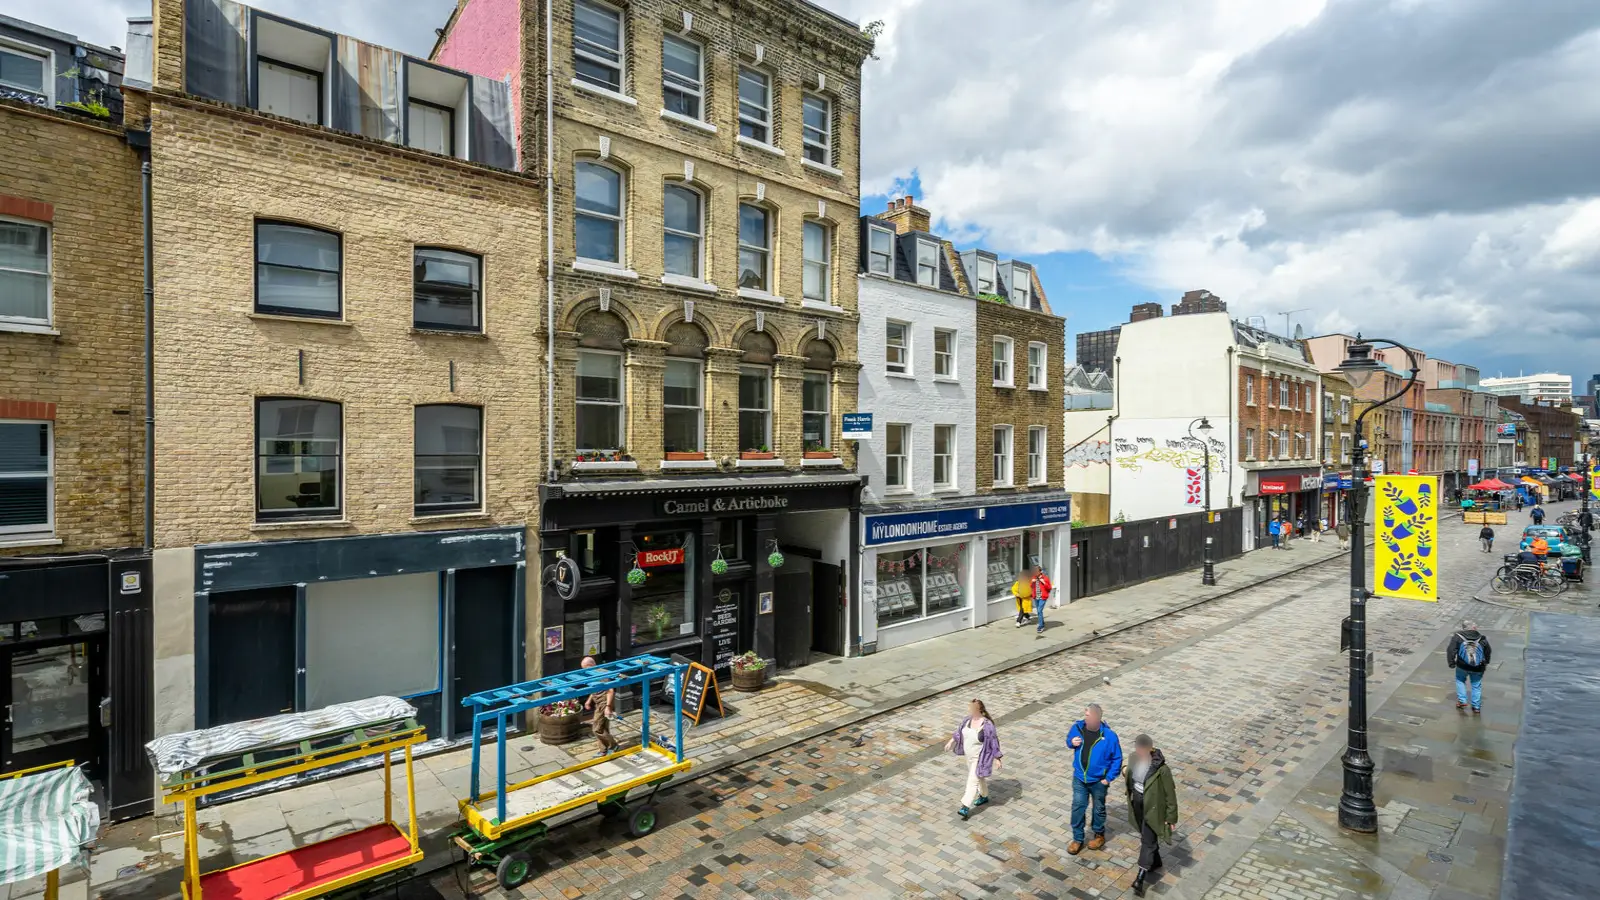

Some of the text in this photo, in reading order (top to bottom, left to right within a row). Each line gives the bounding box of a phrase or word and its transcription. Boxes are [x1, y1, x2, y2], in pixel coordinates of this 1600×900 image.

[663, 495, 789, 515] Camel & Artichoke
[872, 520, 968, 540] MYLONDONHOME ESTATE AGENTS
[713, 617, 737, 627] GARDEN
[718, 638, 732, 646] LIVE
